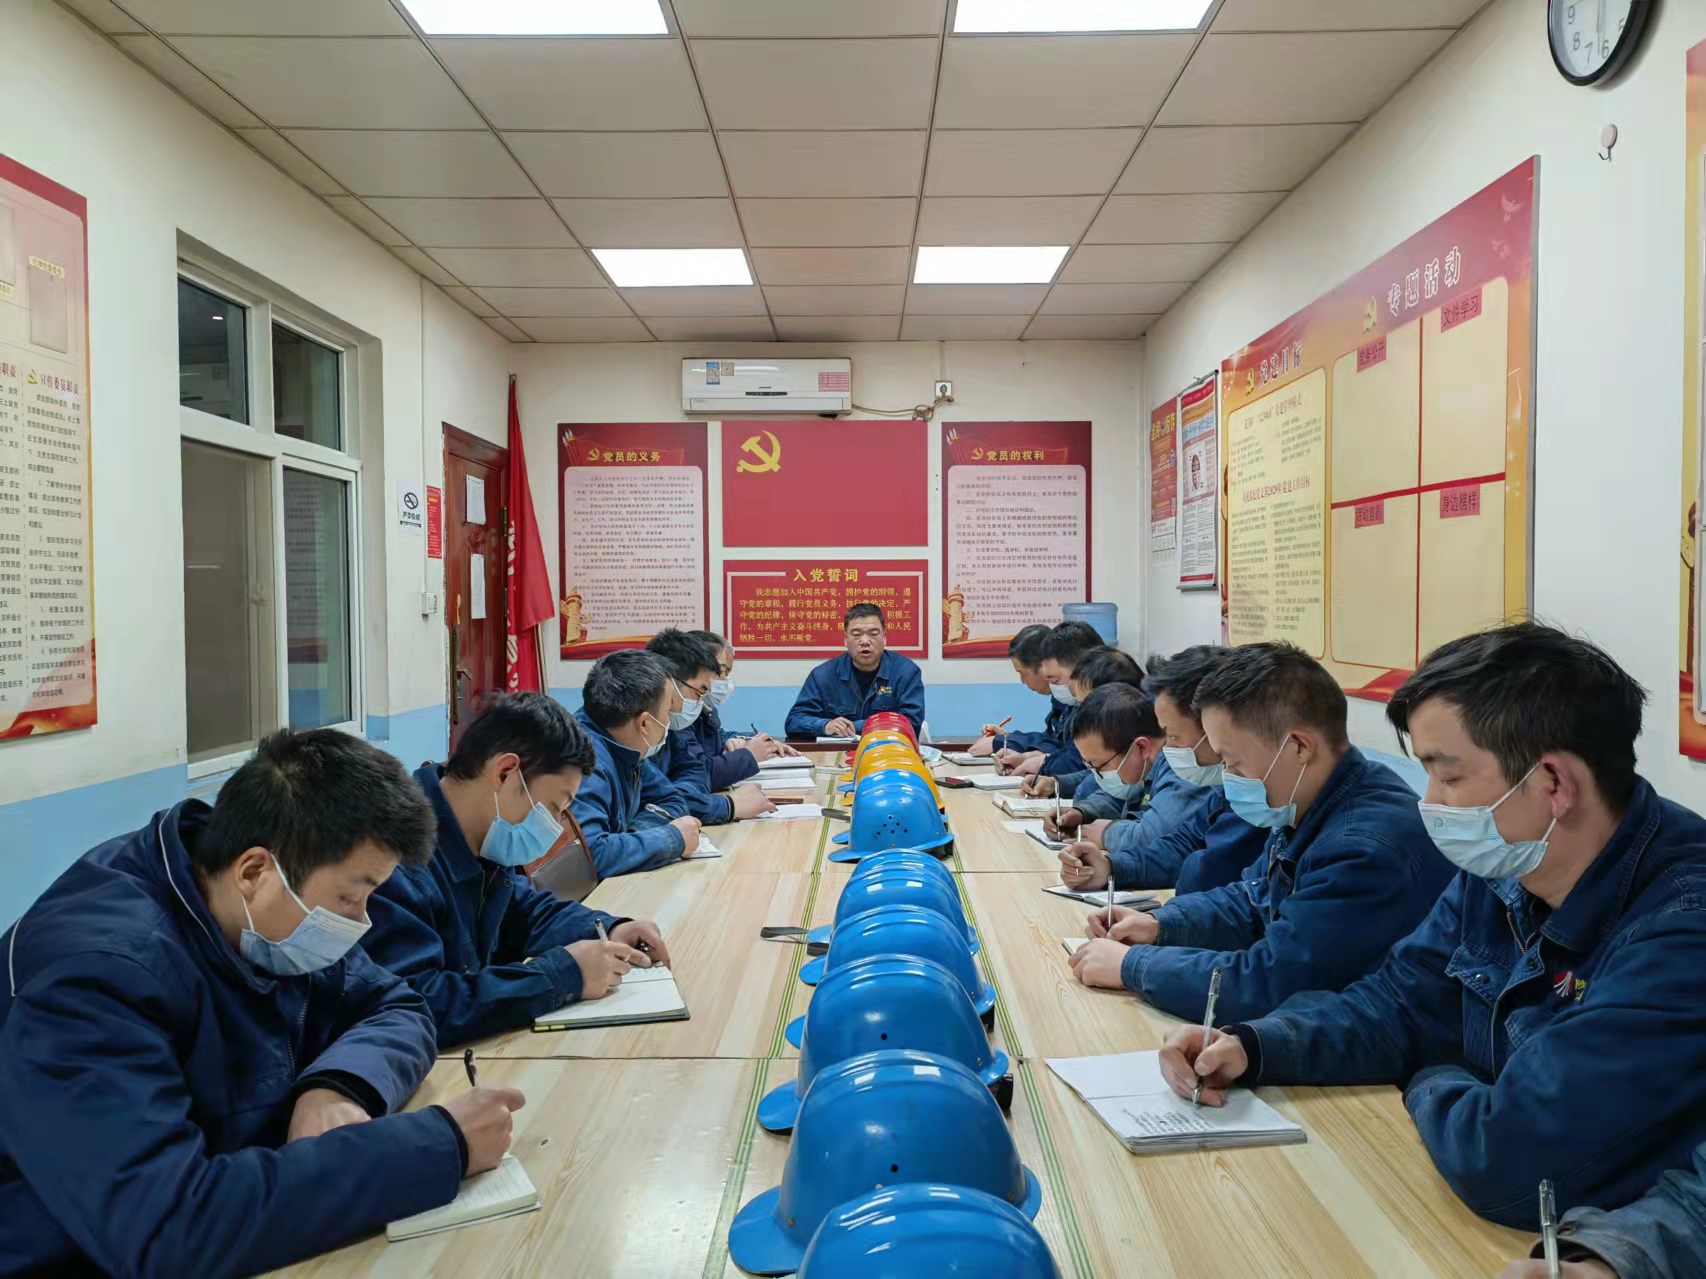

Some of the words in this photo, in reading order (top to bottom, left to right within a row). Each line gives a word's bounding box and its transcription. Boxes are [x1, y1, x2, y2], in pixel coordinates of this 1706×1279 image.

[1573, 32, 1581, 51] 8
[1601, 40, 1610, 59] 6
[1584, 42, 1593, 64] 7
[1387, 246, 1461, 317] 专题活动
[1443, 295, 1480, 327] 文件学习
[603, 451, 660, 462] 党员的义务
[987, 450, 1044, 461] 党员的权利
[1442, 492, 1477, 513] 身边榜样
[793, 568, 859, 583] 入党誓词
